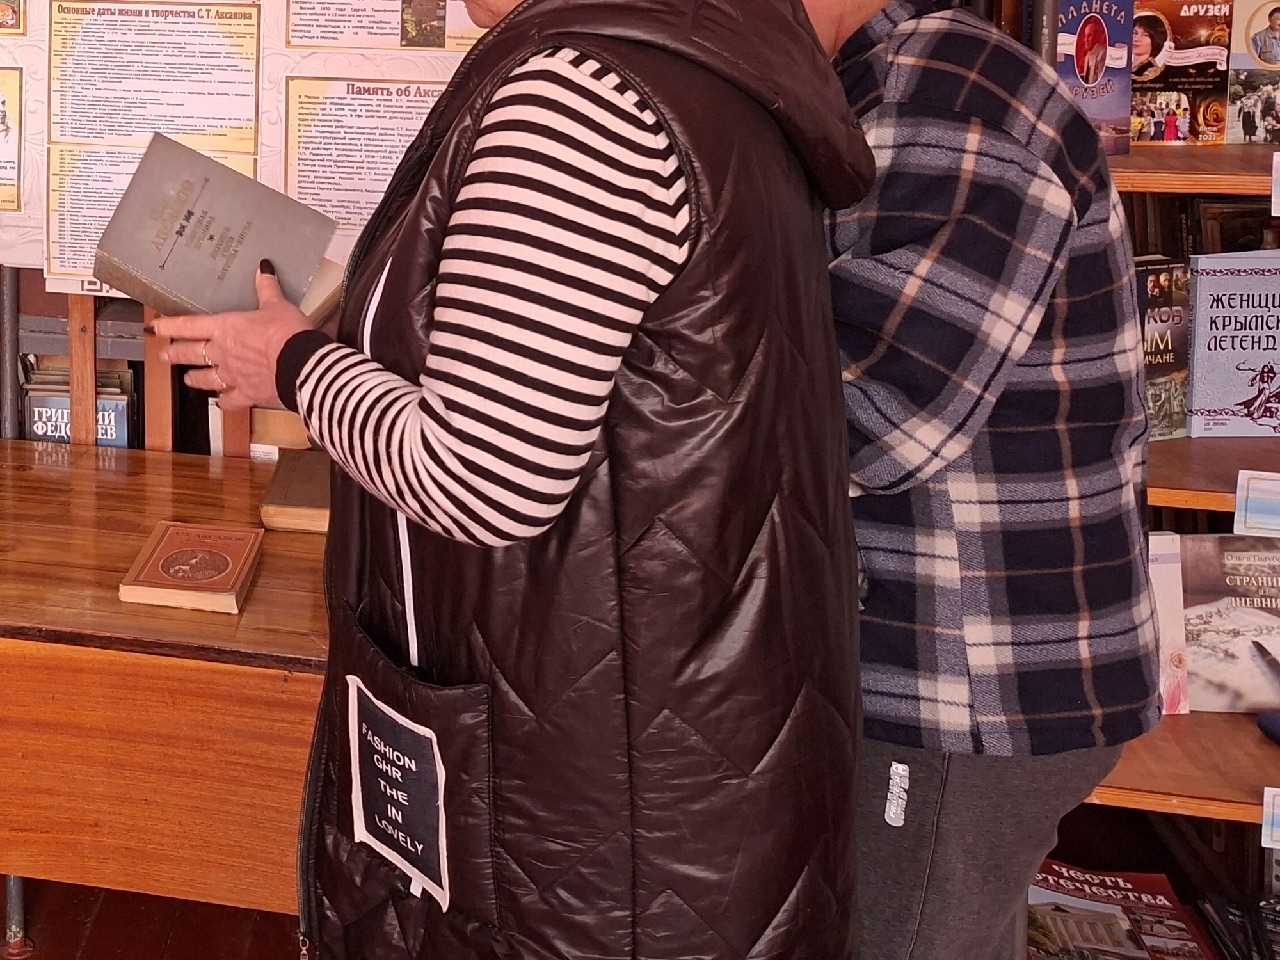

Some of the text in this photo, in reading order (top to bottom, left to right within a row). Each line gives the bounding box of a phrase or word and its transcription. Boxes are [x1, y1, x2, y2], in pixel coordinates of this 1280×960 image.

[57, 4, 253, 21] Основные даты жизни и творчества С. Т. Аксакова
[1180, 4, 1230, 17] ДРУЗЕЙ
[346, 83, 442, 97] Память об Акса
[1207, 334, 1278, 352] ЛЕГЕНД
[361, 722, 417, 772] FASHION
[373, 755, 404, 783] GHR
[377, 777, 409, 805] THE
[387, 803, 403, 825] IN
[374, 813, 425, 856] LOVELY
